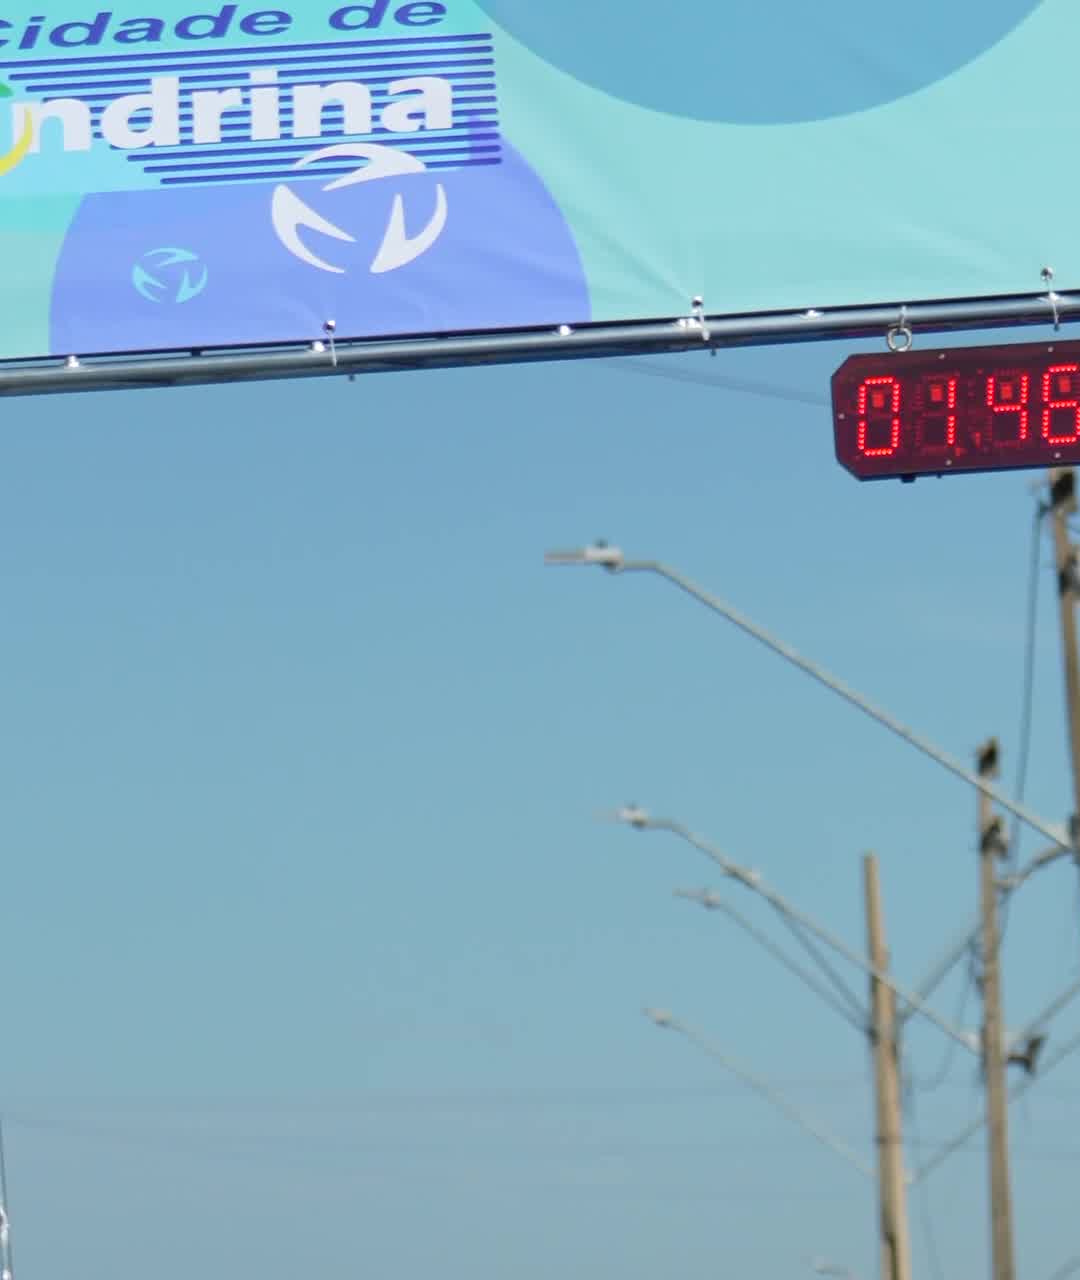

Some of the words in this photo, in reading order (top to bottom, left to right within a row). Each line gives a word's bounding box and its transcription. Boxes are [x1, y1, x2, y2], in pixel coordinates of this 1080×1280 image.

[0, 5, 293, 50] idade
[328, 0, 447, 31] de
[0, 69, 453, 155] ndrina
